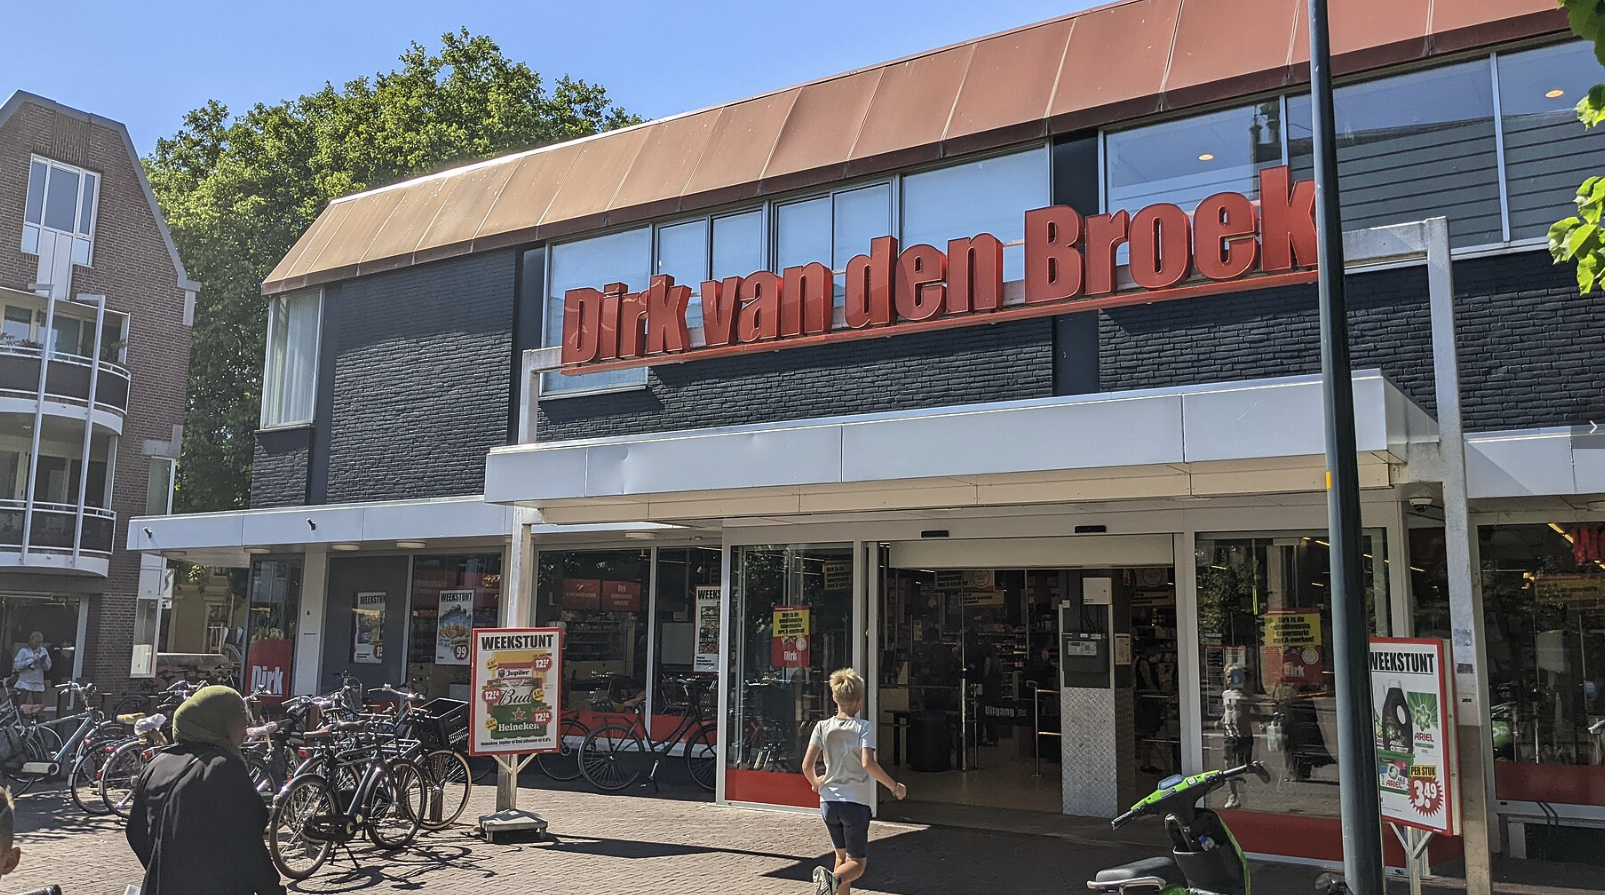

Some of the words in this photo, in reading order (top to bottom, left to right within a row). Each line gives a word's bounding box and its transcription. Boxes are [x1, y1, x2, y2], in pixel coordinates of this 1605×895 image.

[561, 274, 692, 365] Dirk
[700, 262, 832, 347] van
[845, 233, 1003, 329] den
[1025, 165, 1317, 303] Broek
[440, 593, 473, 602] WEEKSTUNT
[481, 634, 553, 650] WEEKSTUNT
[456, 646, 466, 657] 99
[784, 651, 797, 661] Dirk
[251, 666, 283, 694] Dirk
[499, 688, 532, 704] Bud
[985, 706, 1014, 717] Uitgang
[498, 722, 540, 732] Heineken
[1414, 732, 1434, 742] ARIEL
[1411, 765, 1420, 776] PER
[1422, 765, 1436, 776] STUK
[1386, 780, 1402, 788] ARIEL
[1413, 780, 1437, 809] 3.49
